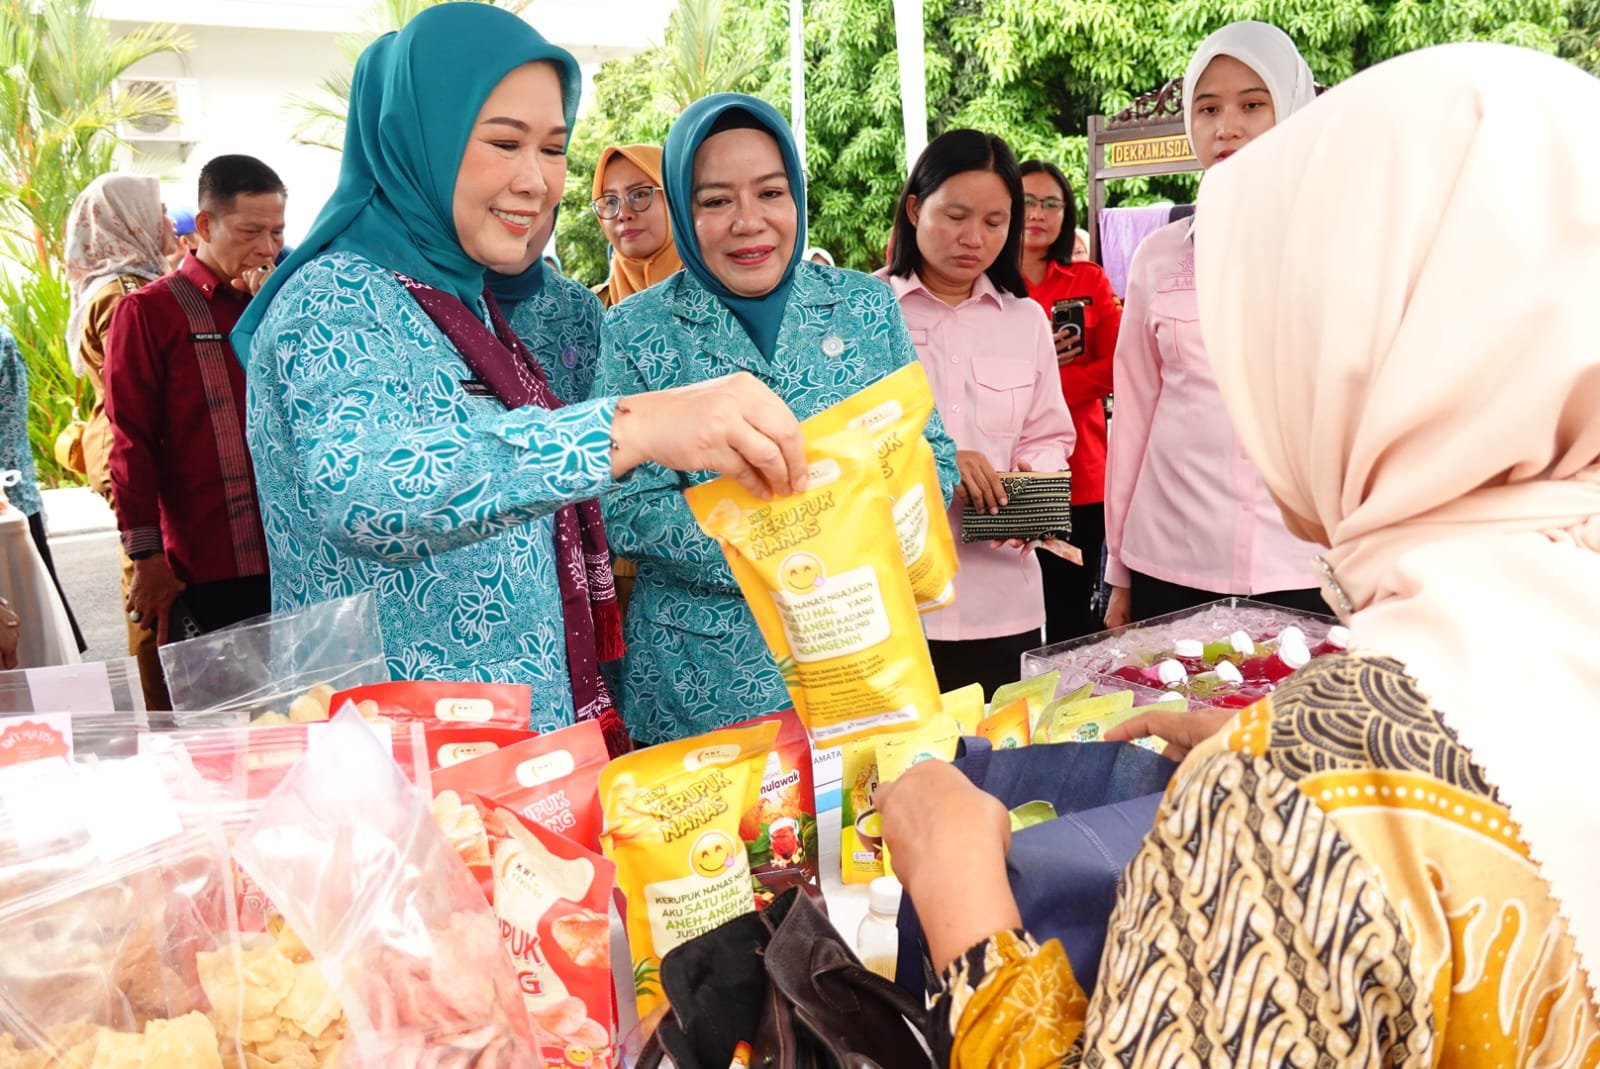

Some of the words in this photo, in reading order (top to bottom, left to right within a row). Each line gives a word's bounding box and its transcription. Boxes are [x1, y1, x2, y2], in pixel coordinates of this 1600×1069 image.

[1115, 139, 1190, 162] DEKRANASDA
[749, 490, 836, 541] KERUPUK
[752, 519, 821, 560] NANAS
[794, 595, 826, 611] NANAS
[812, 605, 838, 619] HAL
[847, 595, 873, 608] YANG
[837, 620, 870, 635] PALING
[650, 769, 732, 822] KERUPUK
[659, 795, 728, 843] NANAS
[655, 891, 701, 905] KERUPUK
[703, 877, 733, 895] NANAS
[663, 909, 683, 917] AKU
[685, 897, 718, 916] SATU
[721, 885, 741, 901] HAL
[666, 901, 737, 930] ANEH-ANEH
[499, 918, 541, 963] PUK
